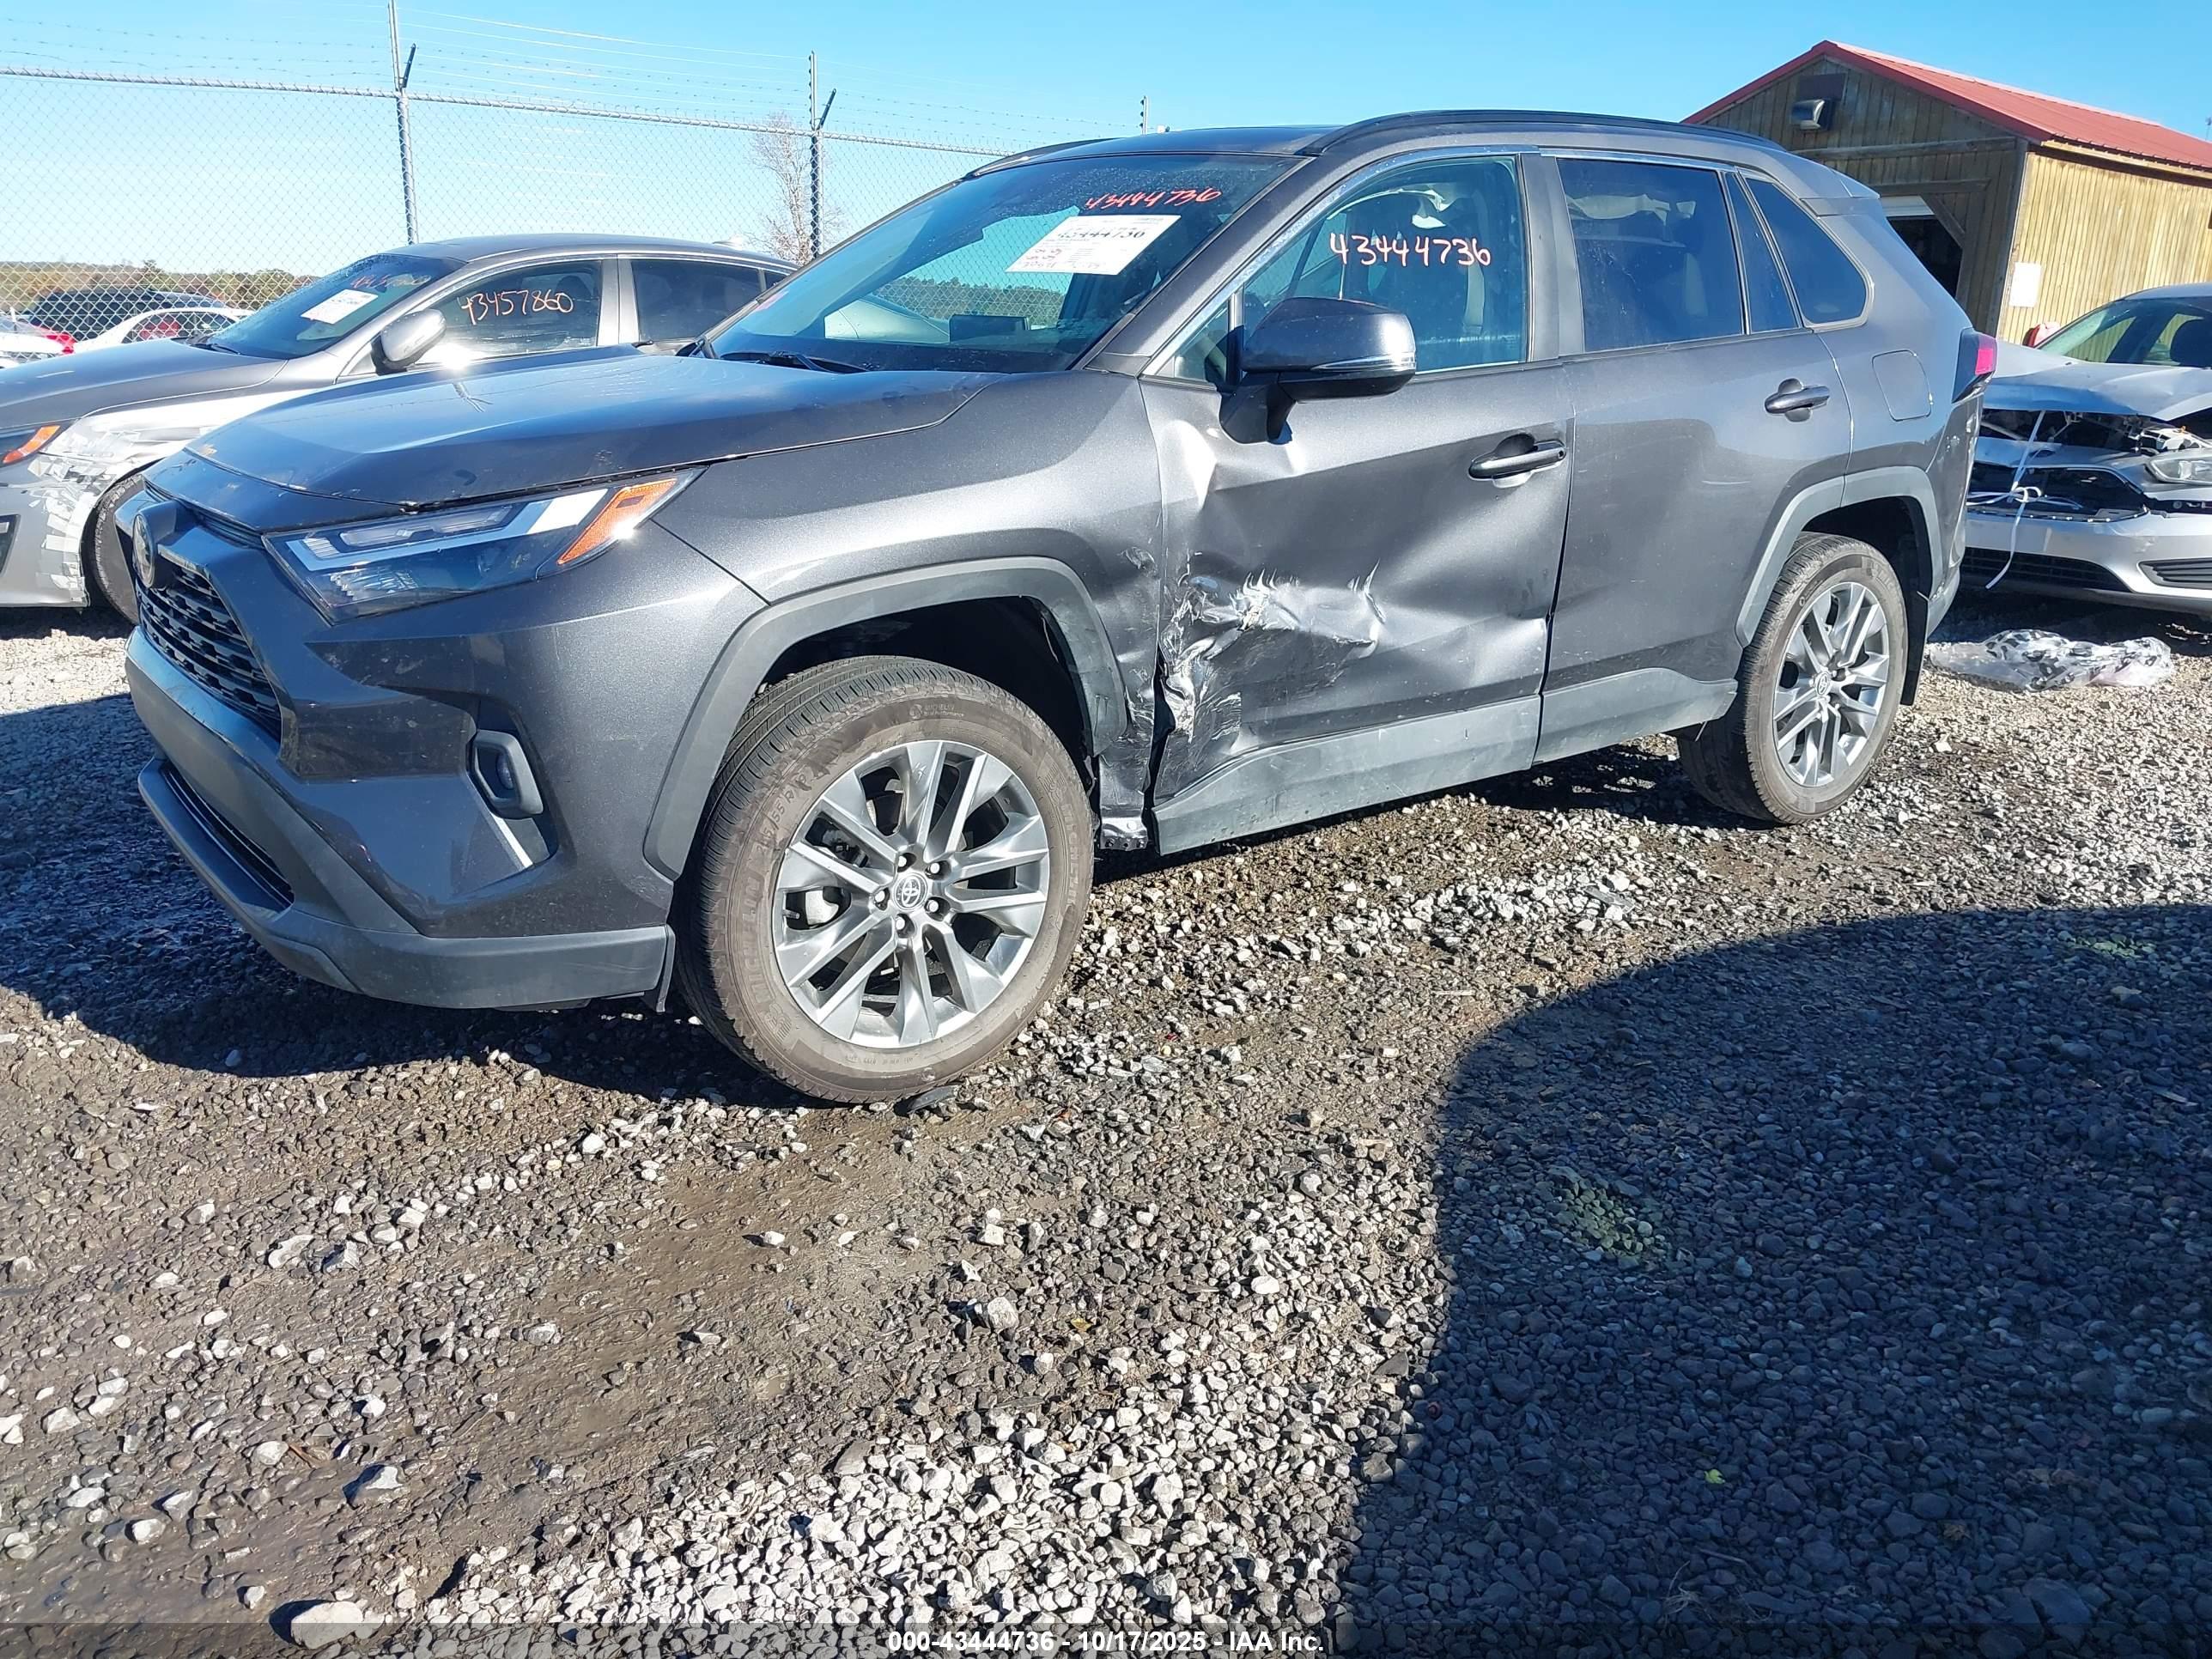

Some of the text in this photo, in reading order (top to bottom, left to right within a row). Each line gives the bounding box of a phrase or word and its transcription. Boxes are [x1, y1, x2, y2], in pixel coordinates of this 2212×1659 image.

[1085, 186, 1222, 210] 43444736
[1329, 232, 1492, 267] 43444736
[456, 289, 574, 325] 43457860
